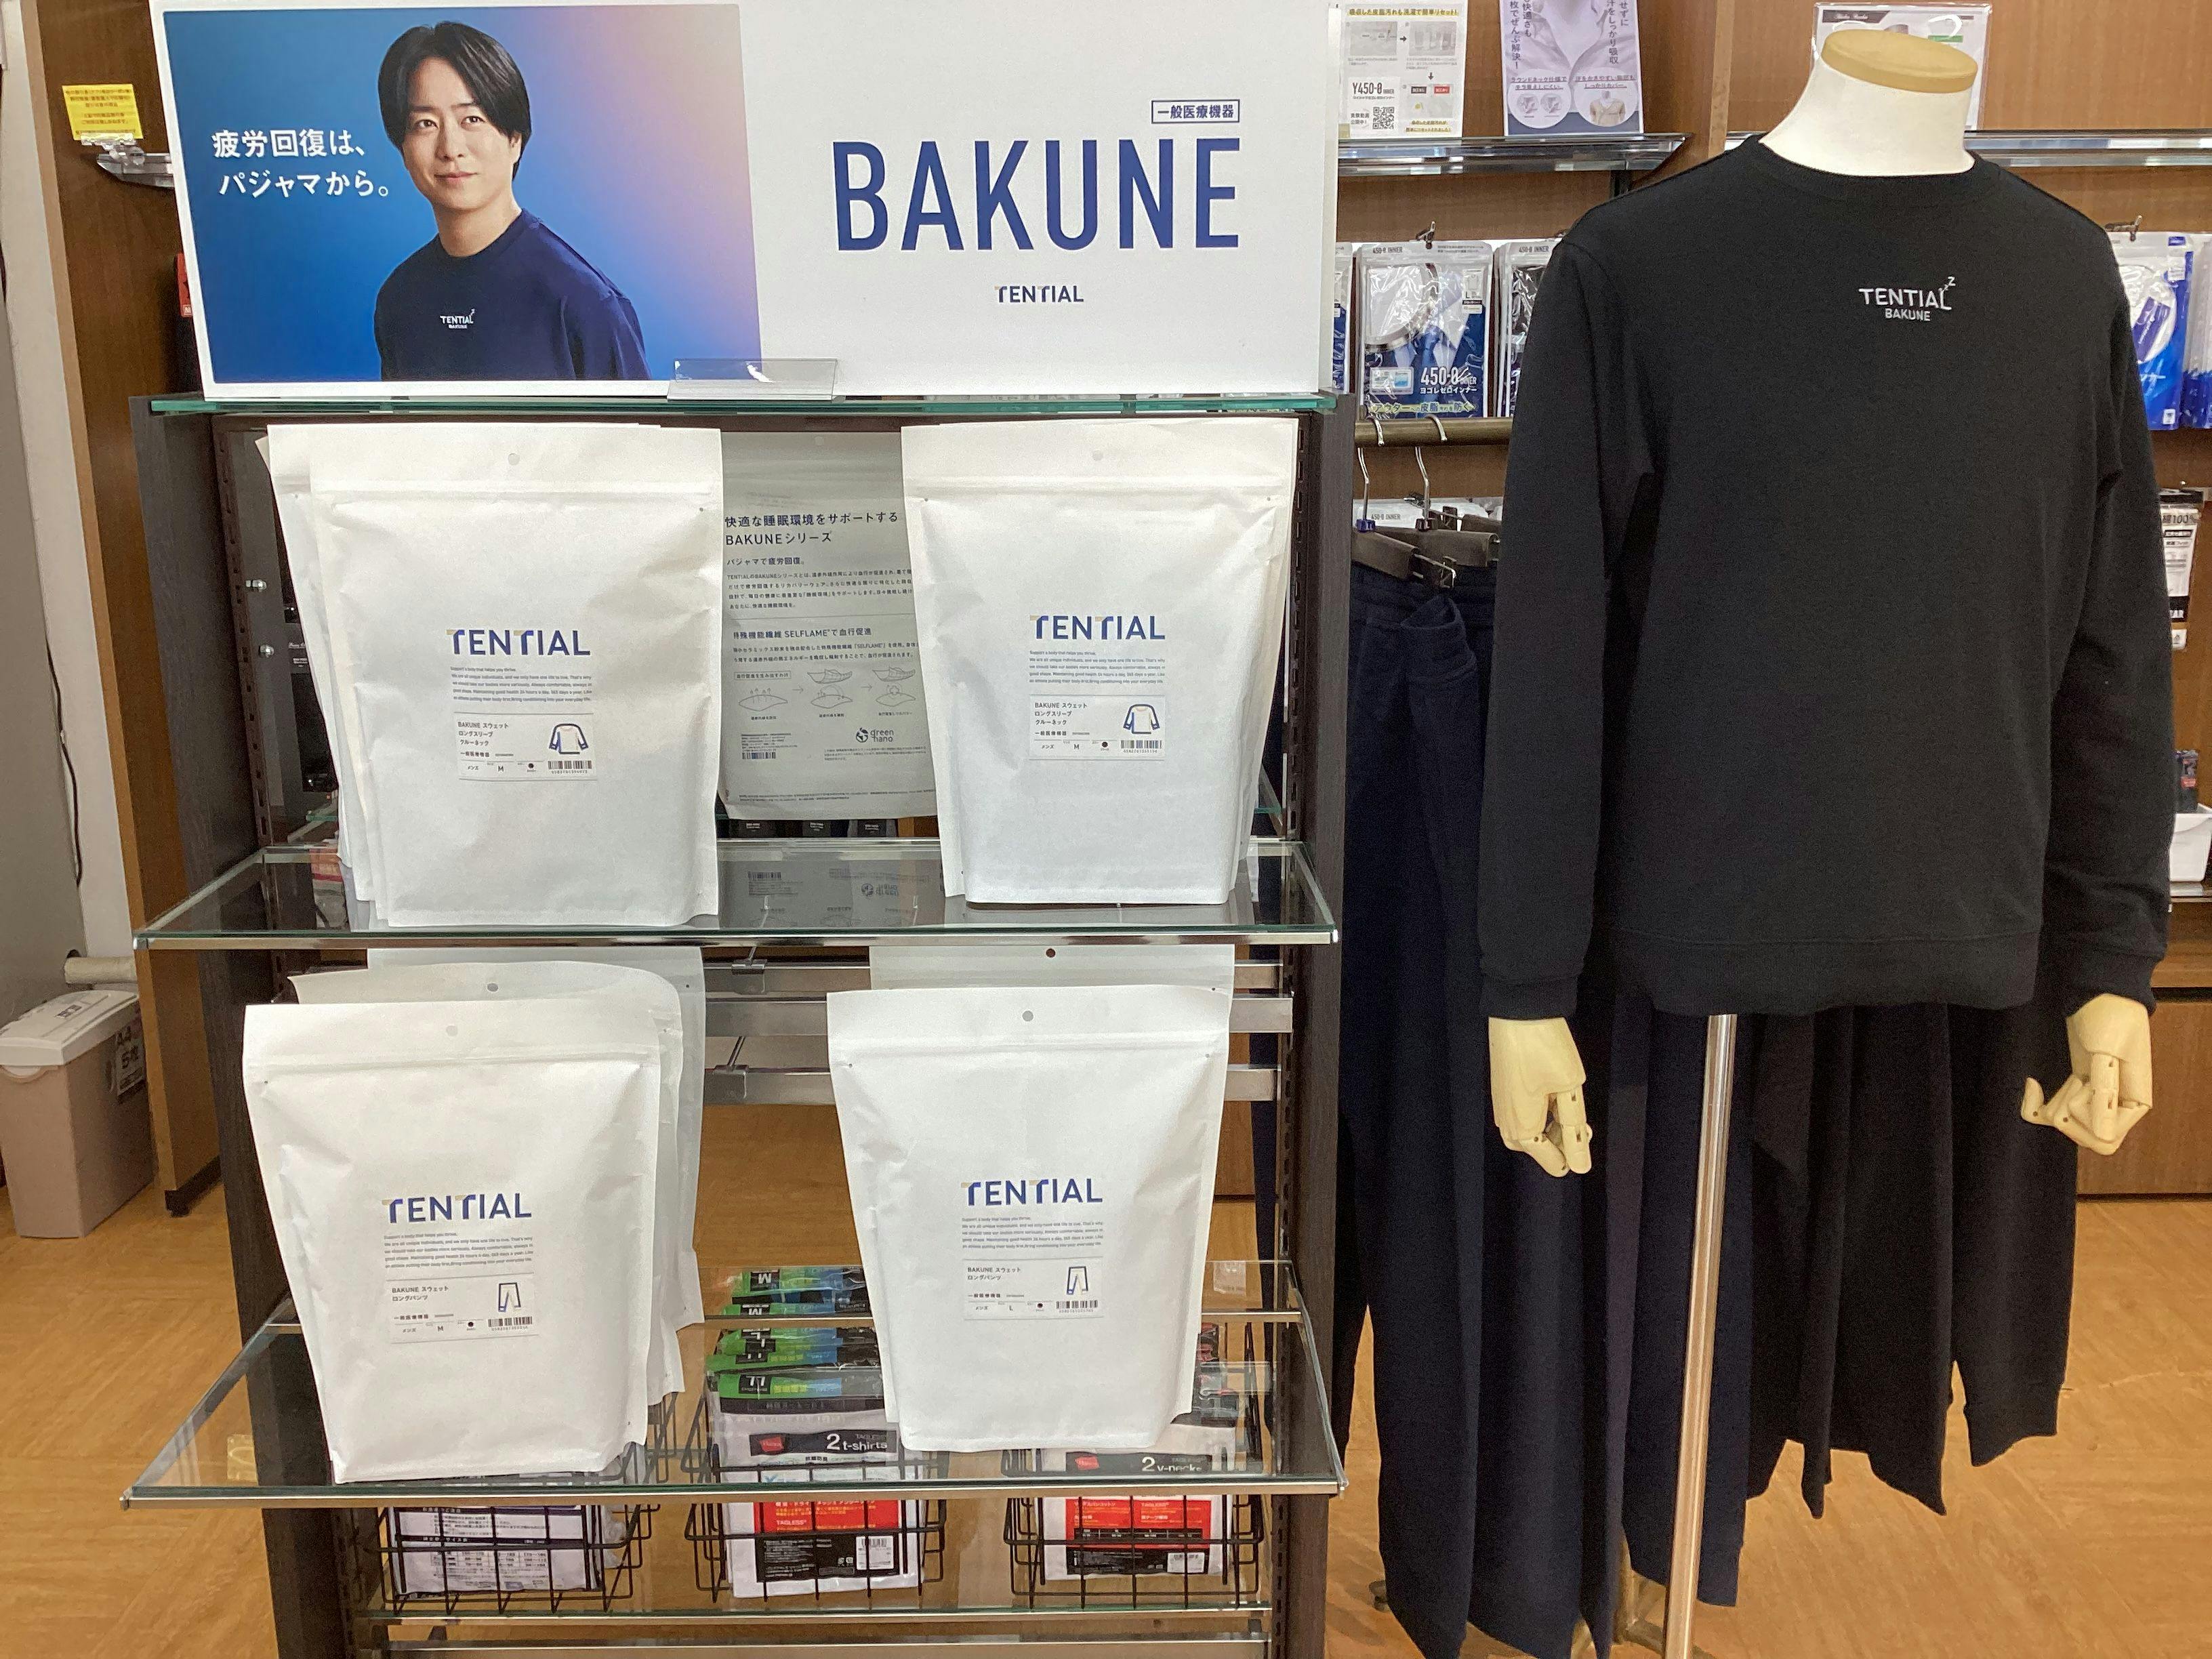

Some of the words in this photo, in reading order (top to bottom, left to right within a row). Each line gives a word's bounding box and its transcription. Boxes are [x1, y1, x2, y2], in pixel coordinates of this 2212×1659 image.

[1522, 0, 1532, 37] 快適さも
[1156, 104, 1235, 121] 一般医療機器
[211, 129, 365, 158] 疲労回復は、
[218, 167, 392, 199] パジャマから。
[832, 138, 1241, 251] BAKUNE
[994, 285, 1084, 304] TENTIAL
[1858, 287, 1952, 311] TENTIAL
[440, 314, 474, 325] TENTIAL
[1885, 308, 1931, 322] BAKUNE
[724, 511, 899, 528] 快適な睡眠環境をサポートする
[725, 531, 833, 546] BAKUNEシリーズ
[726, 556, 805, 565] パジャマで疲労回復。
[1029, 615, 1166, 640] TENTIAL
[446, 629, 591, 656] TENTIAL
[870, 729, 895, 738] green
[961, 1178, 1103, 1206] TENTIAL
[382, 1193, 532, 1224] TENTIAL
[826, 1433, 840, 1450] 2
[842, 1441, 888, 1452] t-shirts
[1141, 1457, 1155, 1472] 2
